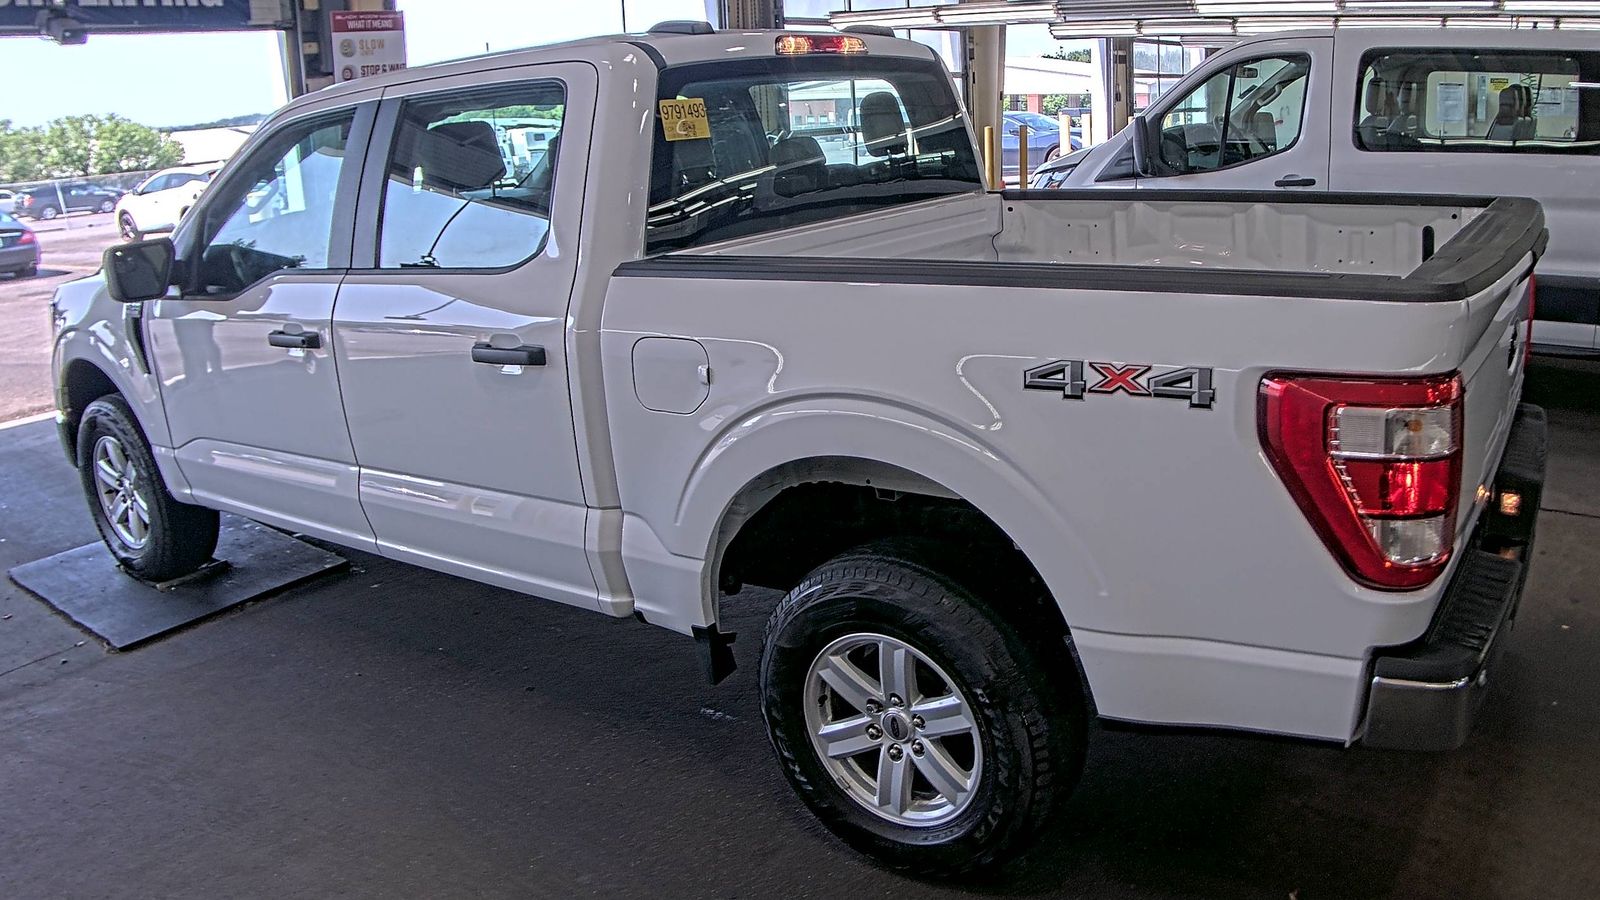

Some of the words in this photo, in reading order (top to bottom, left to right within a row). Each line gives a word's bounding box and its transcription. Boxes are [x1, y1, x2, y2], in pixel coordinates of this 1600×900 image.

[347, 20, 364, 29] WHAT
[365, 19, 372, 29] IT
[372, 19, 393, 29] MEANS
[359, 39, 385, 50] SLOW
[360, 65, 380, 76] STOP
[661, 103, 706, 120] 9791493
